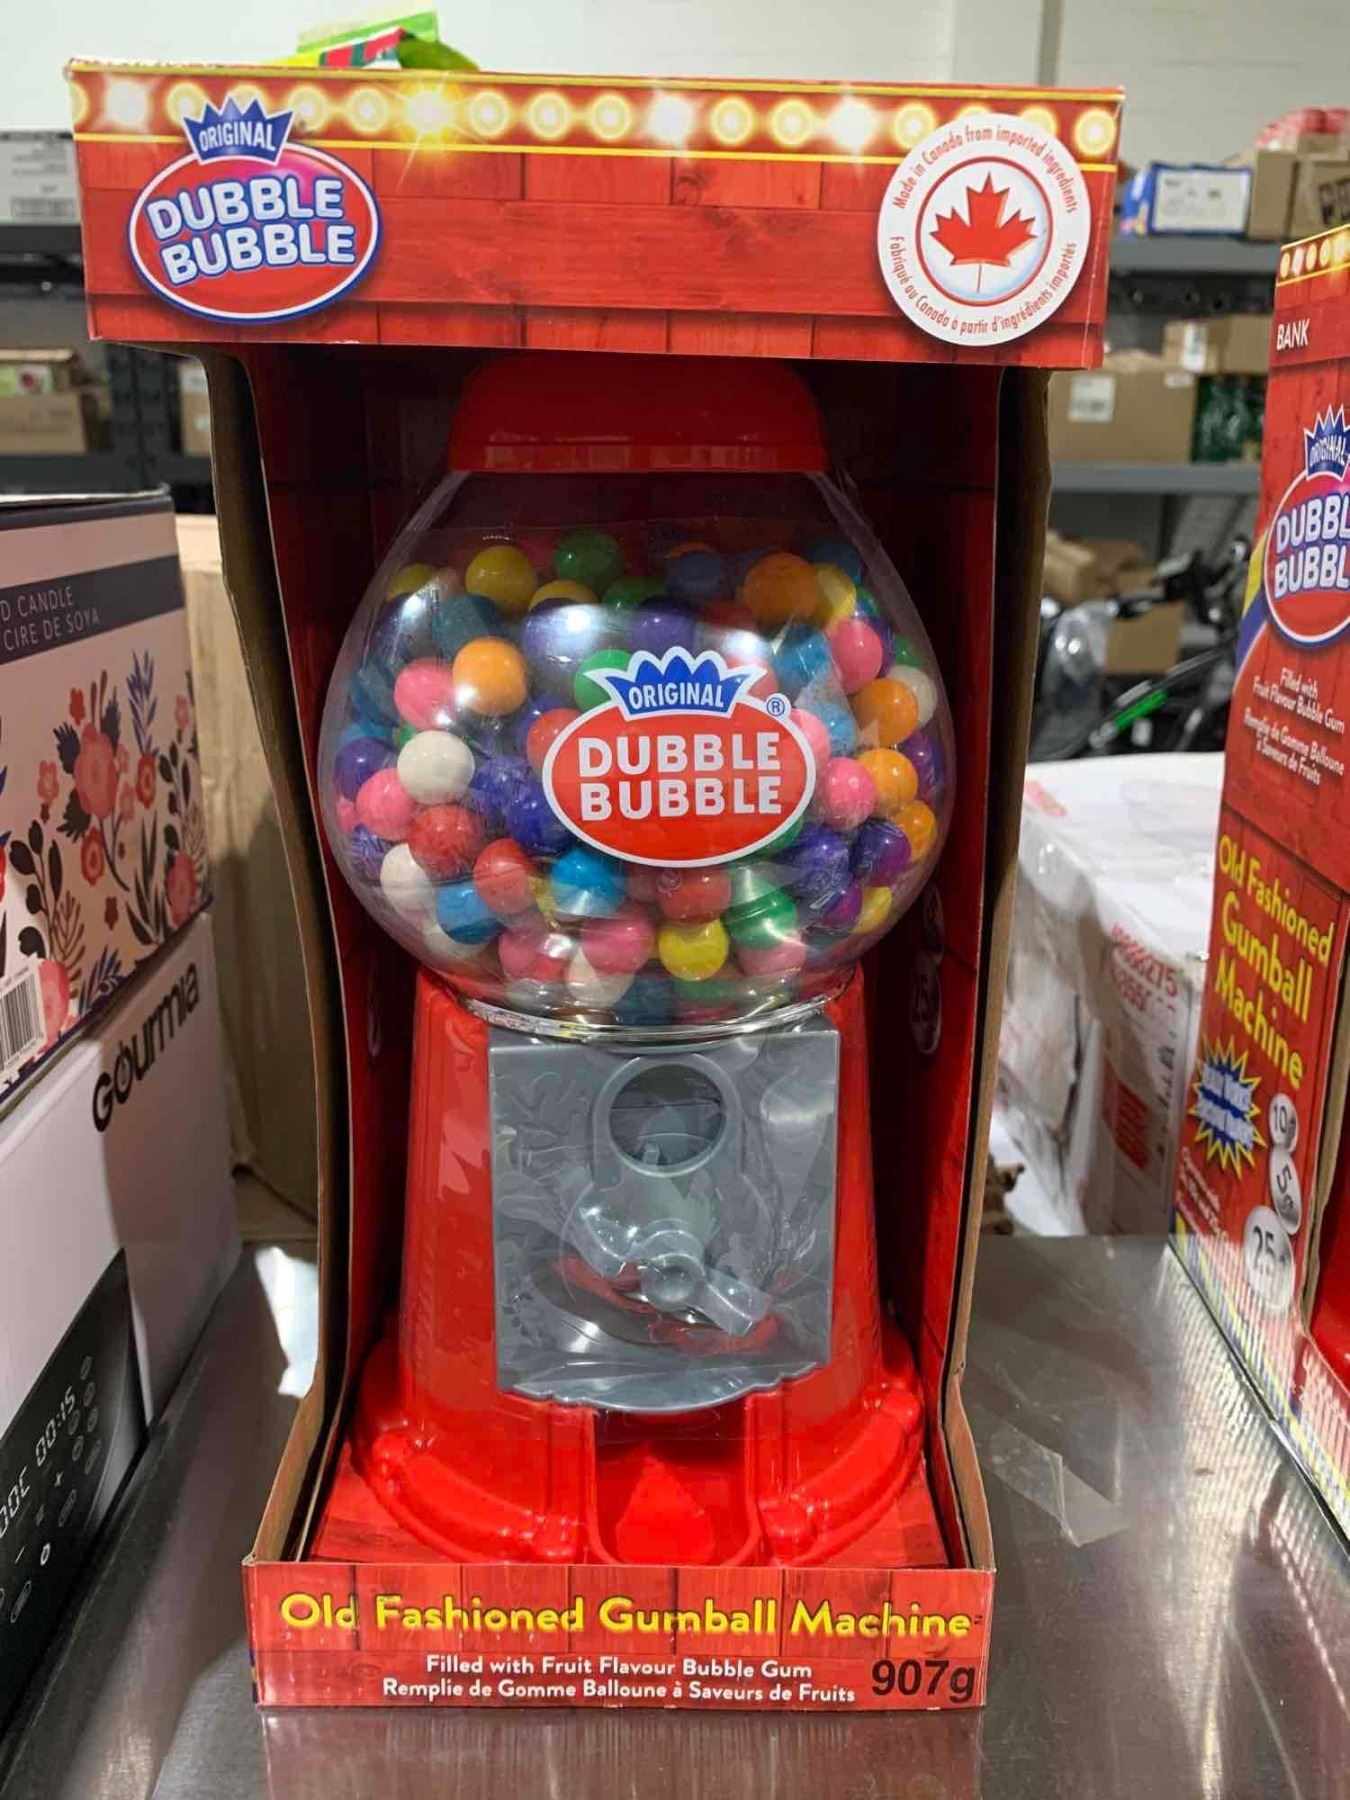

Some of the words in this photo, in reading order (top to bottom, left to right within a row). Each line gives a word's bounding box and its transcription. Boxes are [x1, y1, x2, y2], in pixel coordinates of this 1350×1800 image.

[199, 121, 276, 152] ORIGINAL
[892, 171, 917, 210] Made
[913, 162, 926, 180] in
[921, 130, 964, 166] Canada
[964, 124, 993, 143] from
[996, 124, 1043, 157] imported
[1042, 144, 1079, 214] ingredients
[146, 177, 344, 241] DUBBLE
[160, 222, 356, 285] BUBBLE
[905, 281, 918, 302] au
[914, 293, 951, 327] Canada
[959, 317, 991, 337] partir
[1050, 241, 1078, 293] importés
[1276, 317, 1311, 351] BANK
[1309, 434, 1346, 467] ORIGINAL
[17, 586, 73, 617] CANDLE
[3, 621, 40, 652] CIRE
[43, 615, 62, 641] DE
[66, 606, 100, 634] SOYA
[628, 680, 724, 709] ORIGINAL
[1324, 707, 1345, 735] Gum
[578, 731, 782, 778] DUBBLE
[580, 775, 782, 822] BUBBLE
[1218, 834, 1246, 888] Old
[1247, 857, 1335, 968] Fashioned
[1222, 890, 1313, 1025] Gumball
[1215, 948, 1304, 1090] Machine
[92, 962, 200, 1133] Gourmia
[280, 1593, 357, 1628] Old
[375, 1594, 584, 1634] Fashioned
[598, 1596, 777, 1636] Gumball
[789, 1599, 971, 1638] Machine
[382, 1677, 464, 1701] Remplie
[468, 1679, 492, 1697] de
[498, 1680, 577, 1698] Gomme
[583, 1679, 667, 1699] Balloune
[673, 1680, 682, 1699] à
[688, 1682, 764, 1701] Saveurs
[769, 1684, 793, 1702] de
[799, 1684, 856, 1703] Fruits
[426, 1655, 484, 1674] Filled
[488, 1656, 535, 1675] with
[541, 1657, 592, 1675] Fruit
[599, 1657, 675, 1677] Flavour
[682, 1658, 755, 1680] Bubble
[761, 1660, 813, 1679] Gum
[870, 1658, 976, 1704] 907g
